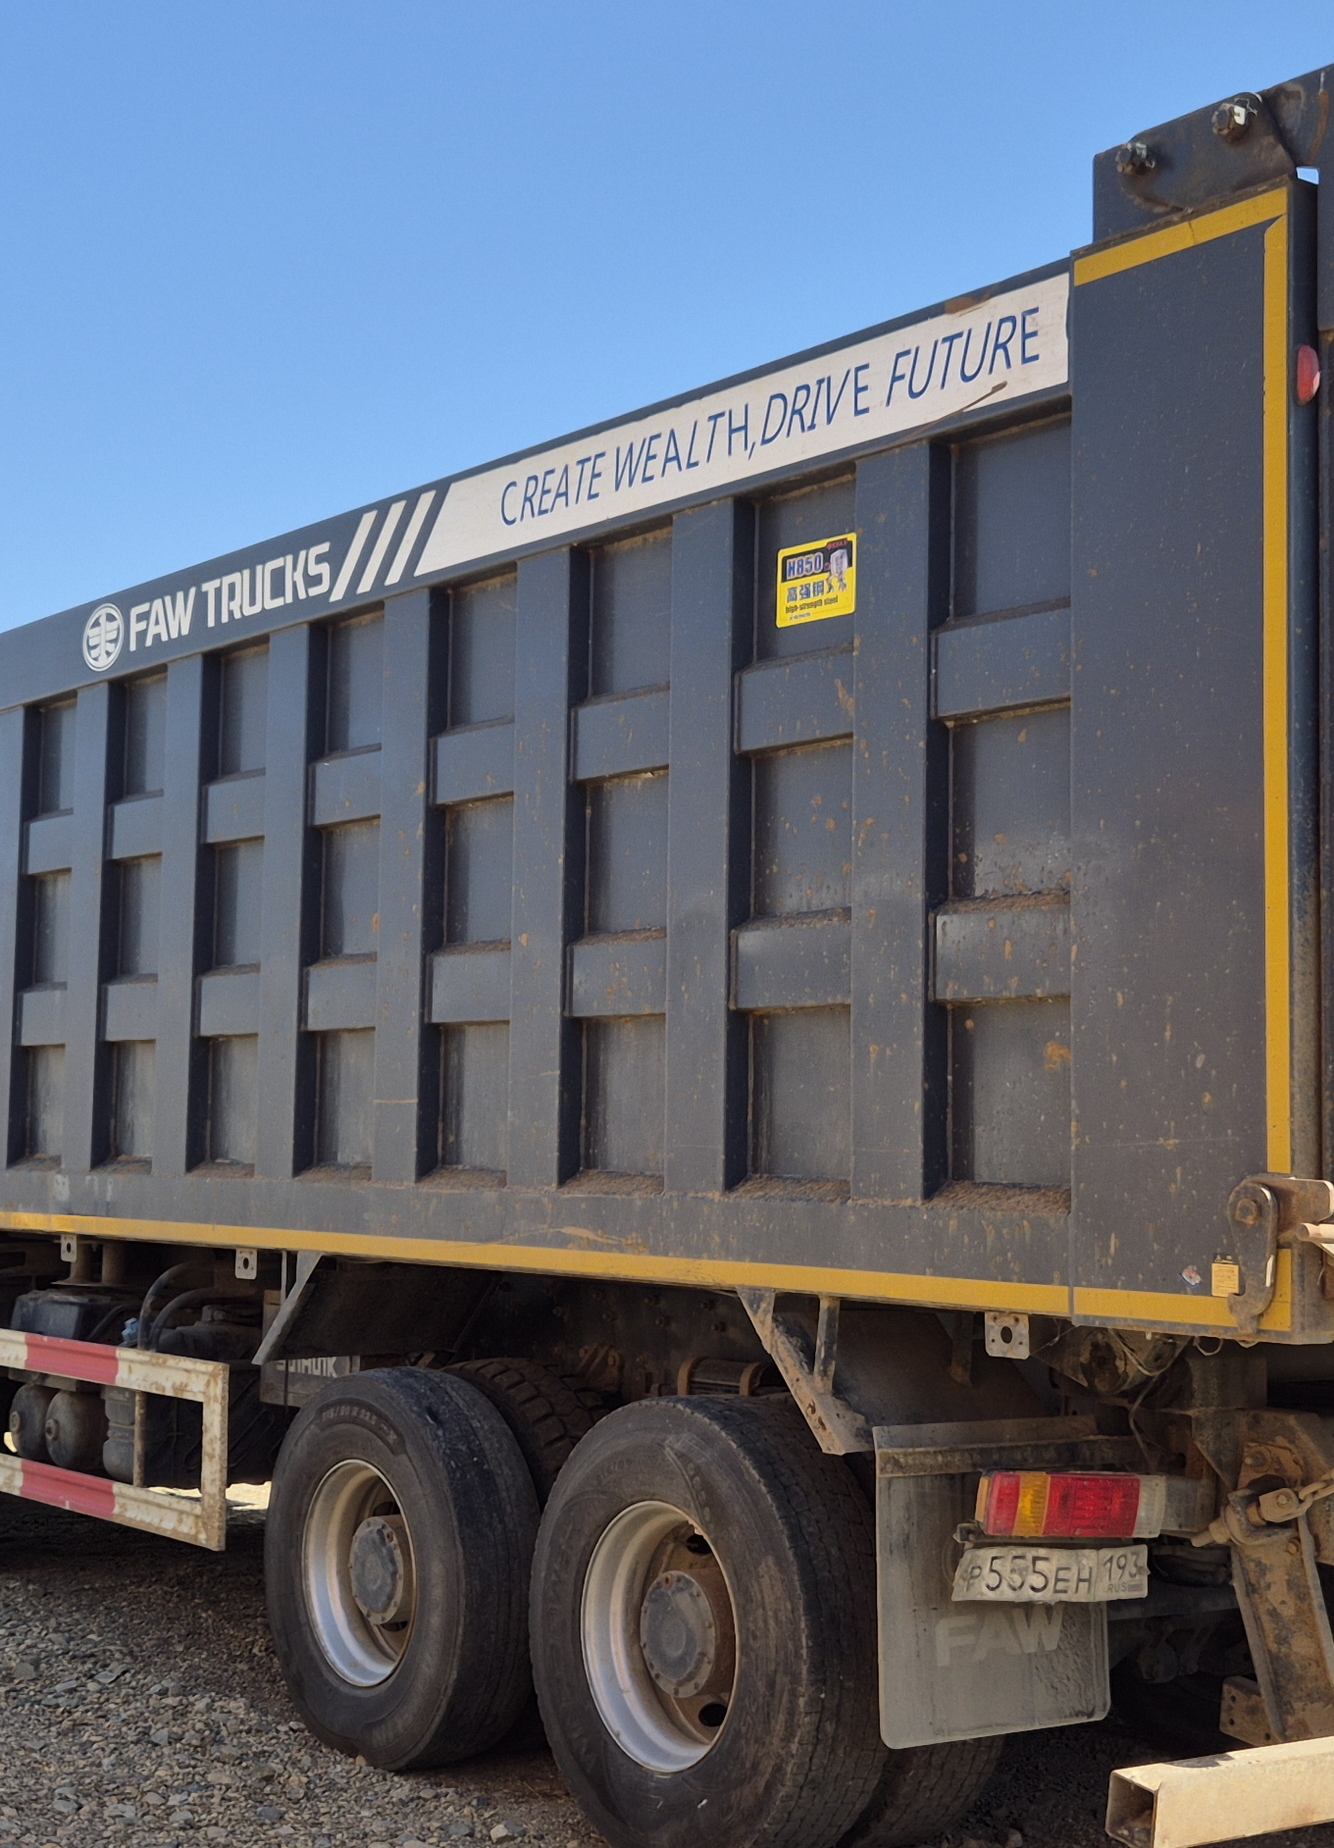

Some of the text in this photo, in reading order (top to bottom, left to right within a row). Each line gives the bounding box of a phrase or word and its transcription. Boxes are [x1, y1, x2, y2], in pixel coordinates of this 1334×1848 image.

[500, 451, 606, 526] CREATE
[885, 306, 1040, 407] FUTURE
[129, 541, 331, 652] FAW TRUCKS
[786, 552, 823, 580] H850
[1106, 1583, 1128, 1594] RUS
[935, 1603, 1064, 1668] FAW
